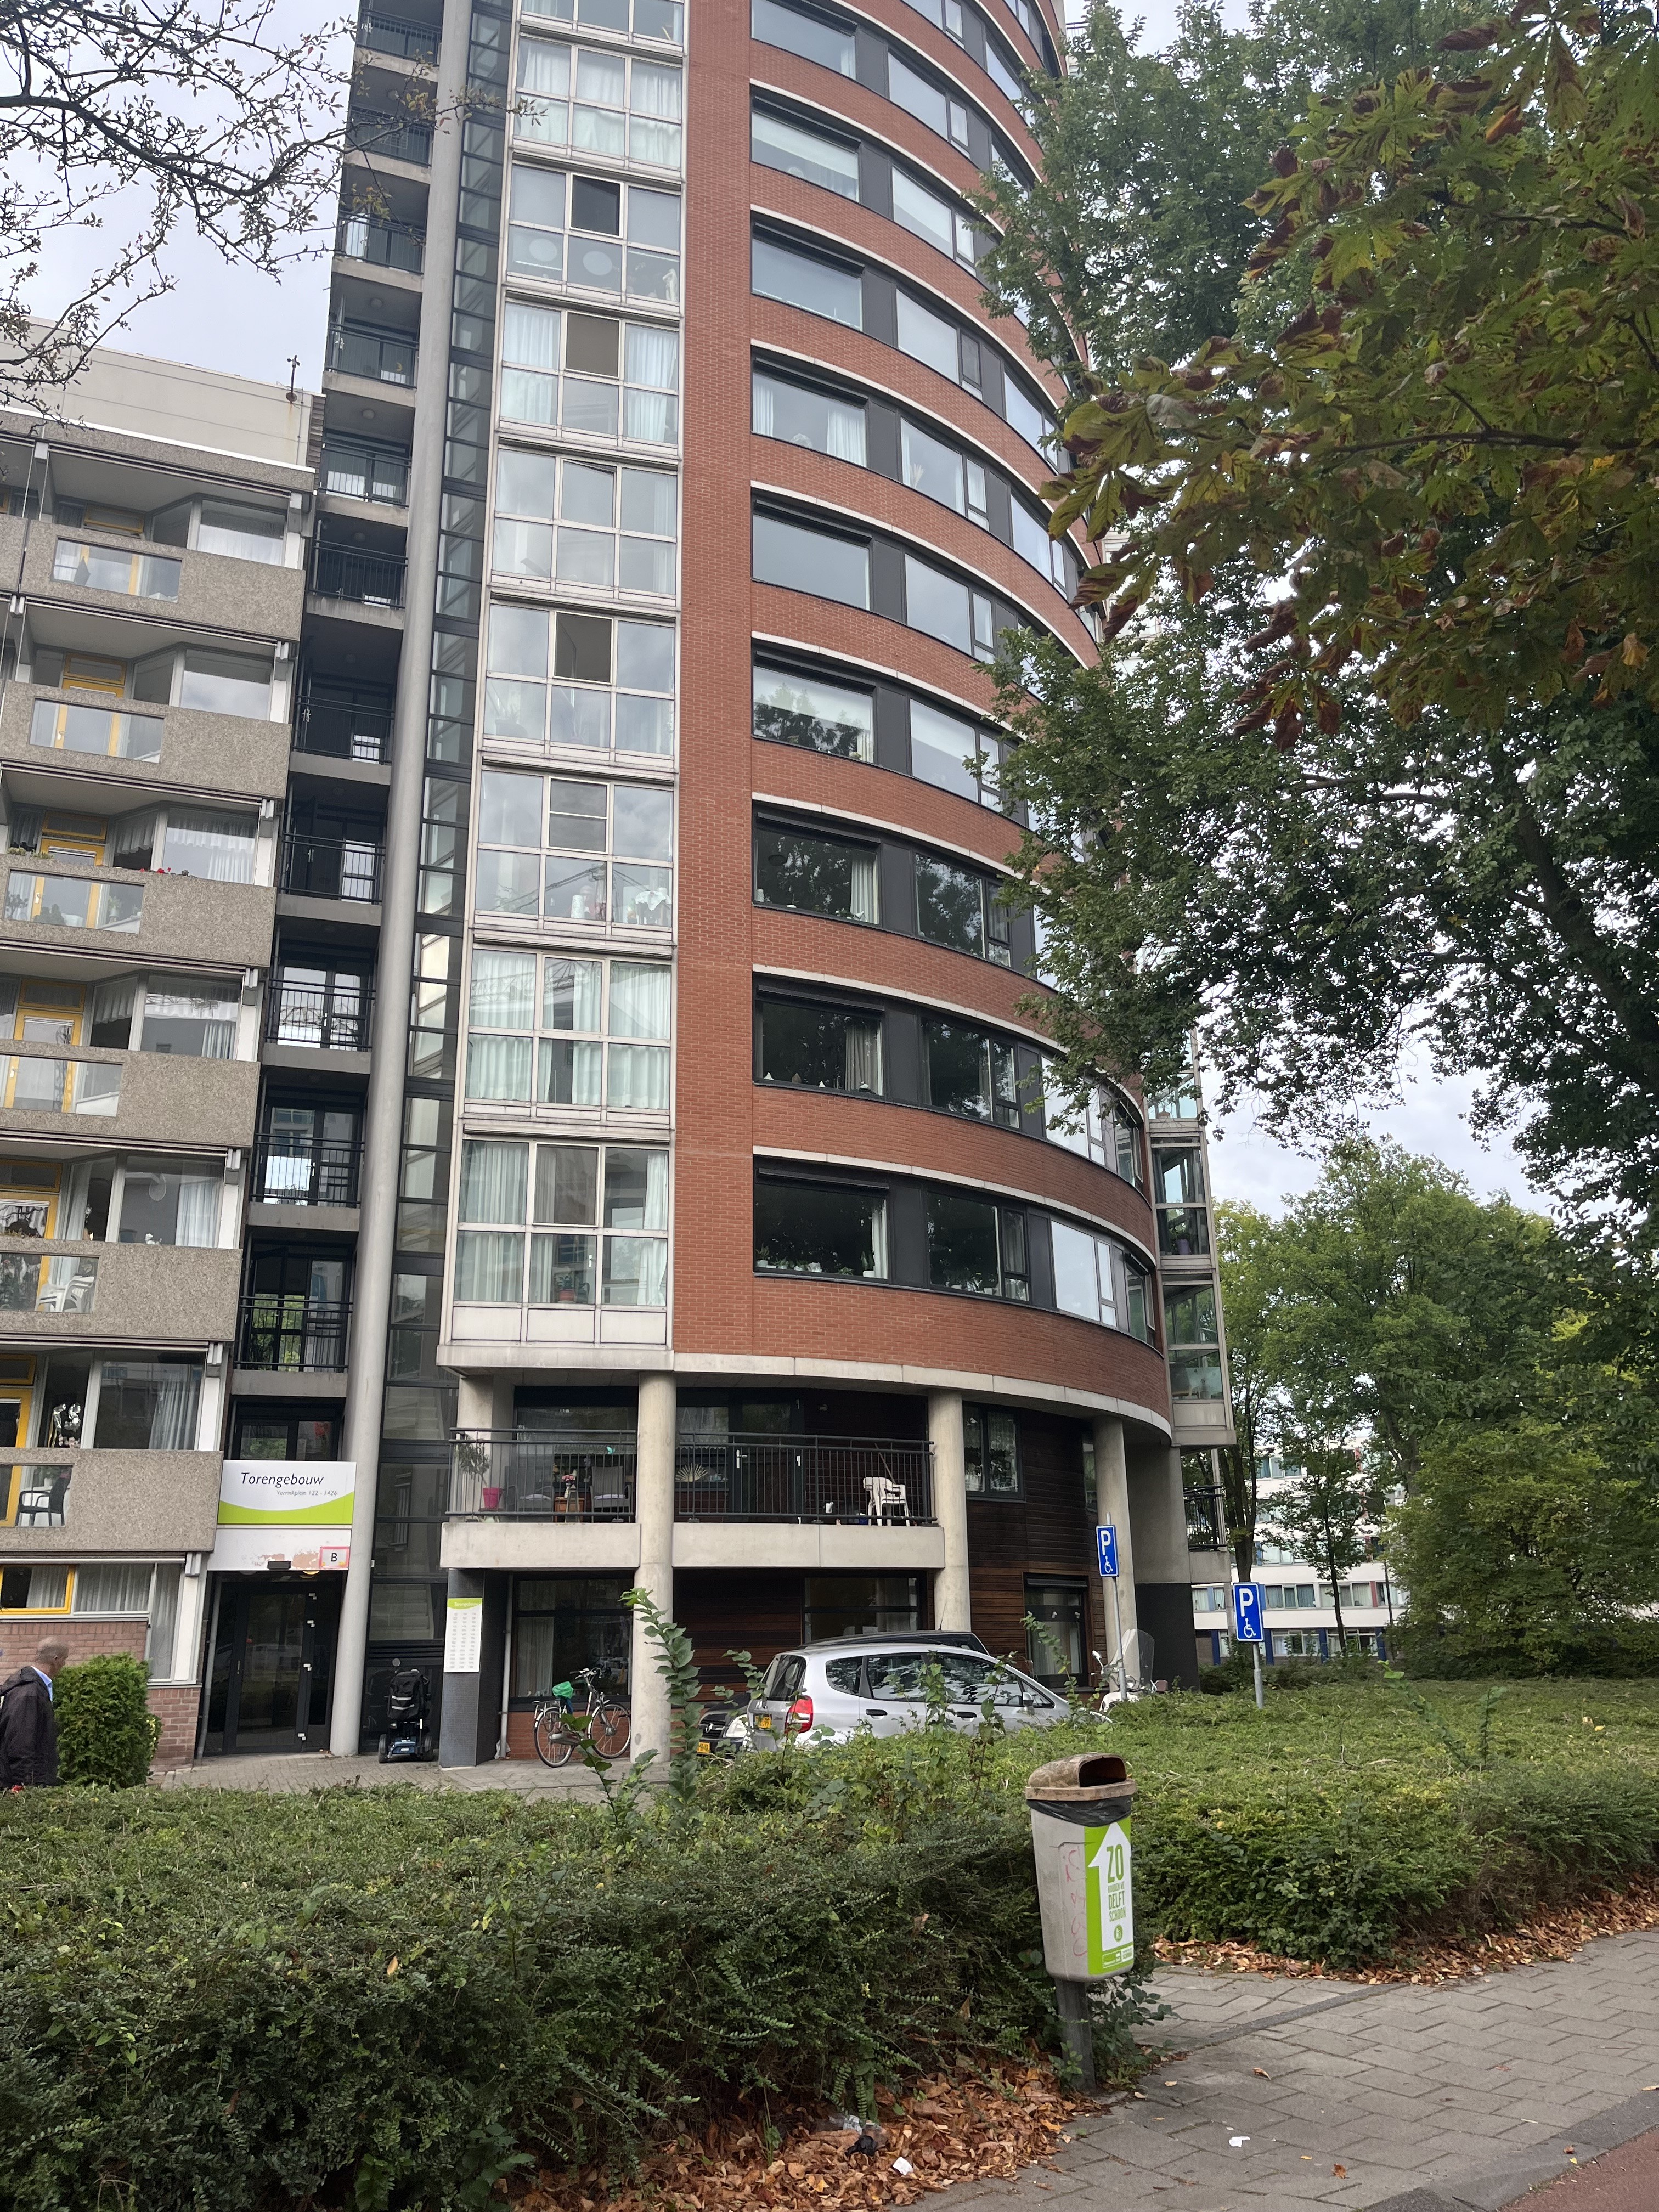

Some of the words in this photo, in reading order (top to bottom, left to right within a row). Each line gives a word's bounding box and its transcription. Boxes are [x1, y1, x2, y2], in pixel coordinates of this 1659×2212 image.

[241, 1472, 324, 1488] Torengebouw
[1100, 1530, 1111, 1555] P
[331, 1553, 337, 1562] B
[1238, 1588, 1254, 1617] P
[1106, 1843, 1124, 1883] ZO
[1108, 1890, 1125, 1910] DELFT
